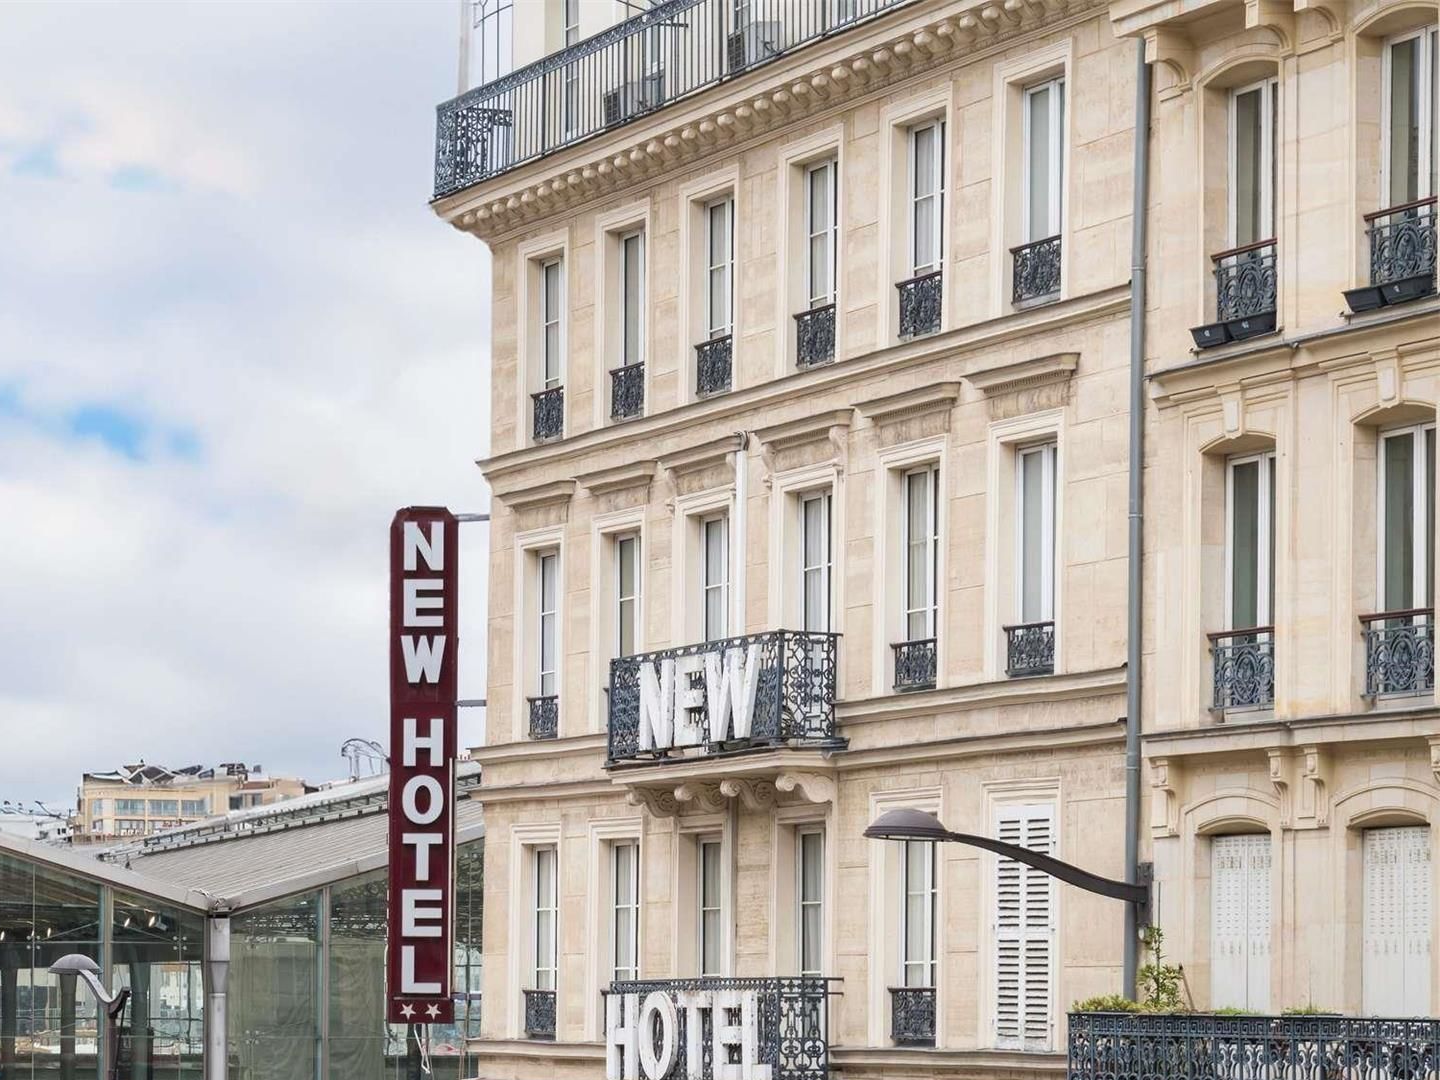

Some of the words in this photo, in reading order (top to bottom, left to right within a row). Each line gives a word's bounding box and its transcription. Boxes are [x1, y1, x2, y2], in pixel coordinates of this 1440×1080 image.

[400, 521, 446, 684] NEW
[639, 643, 760, 751] NEW
[400, 718, 444, 995] HOTEL
